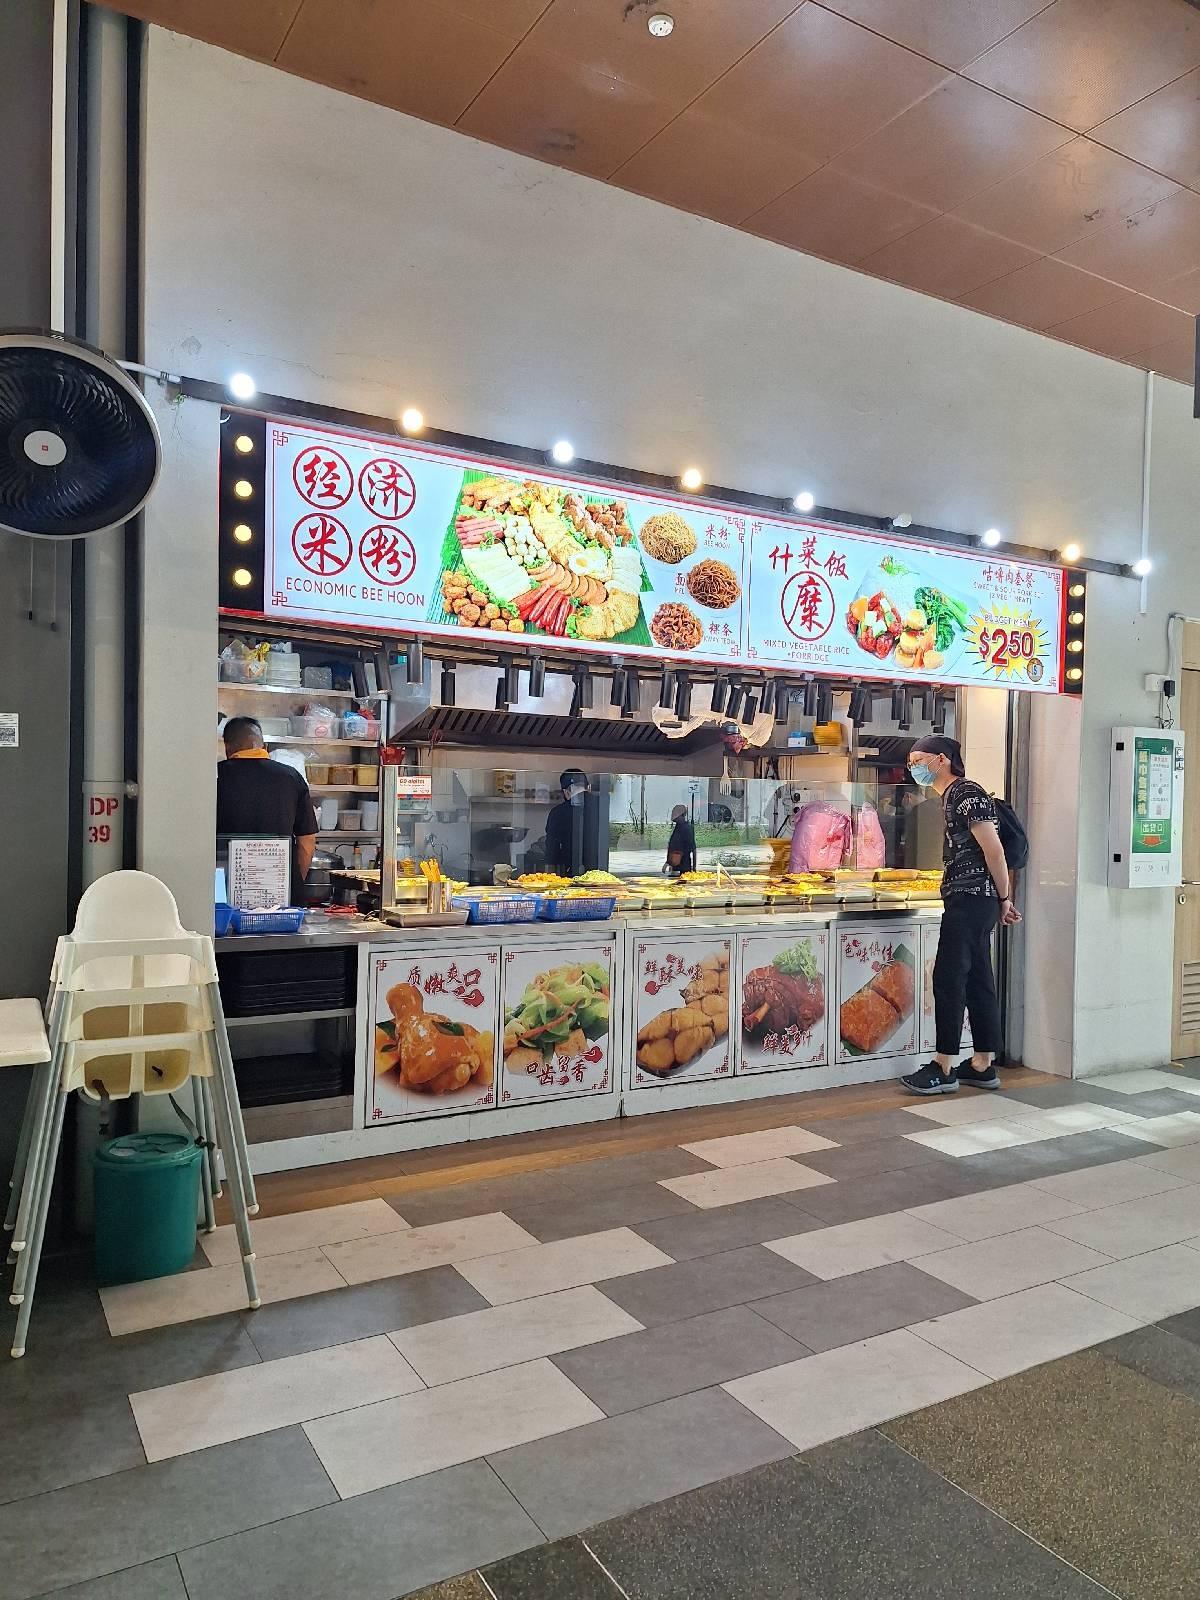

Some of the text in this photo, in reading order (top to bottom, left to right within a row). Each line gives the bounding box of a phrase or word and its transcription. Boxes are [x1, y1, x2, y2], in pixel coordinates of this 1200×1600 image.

[303, 454, 413, 516] 经济
[301, 516, 412, 577] 米粉
[769, 536, 849, 580] 什菜饭
[286, 577, 425, 607] ECONOMIC BEE HOON
[763, 639, 850, 655] MIXED VEGETABLE RICE
[90, 797, 119, 816] DP
[89, 825, 110, 843] 39
[526, 1056, 587, 1085] 口齿留香
